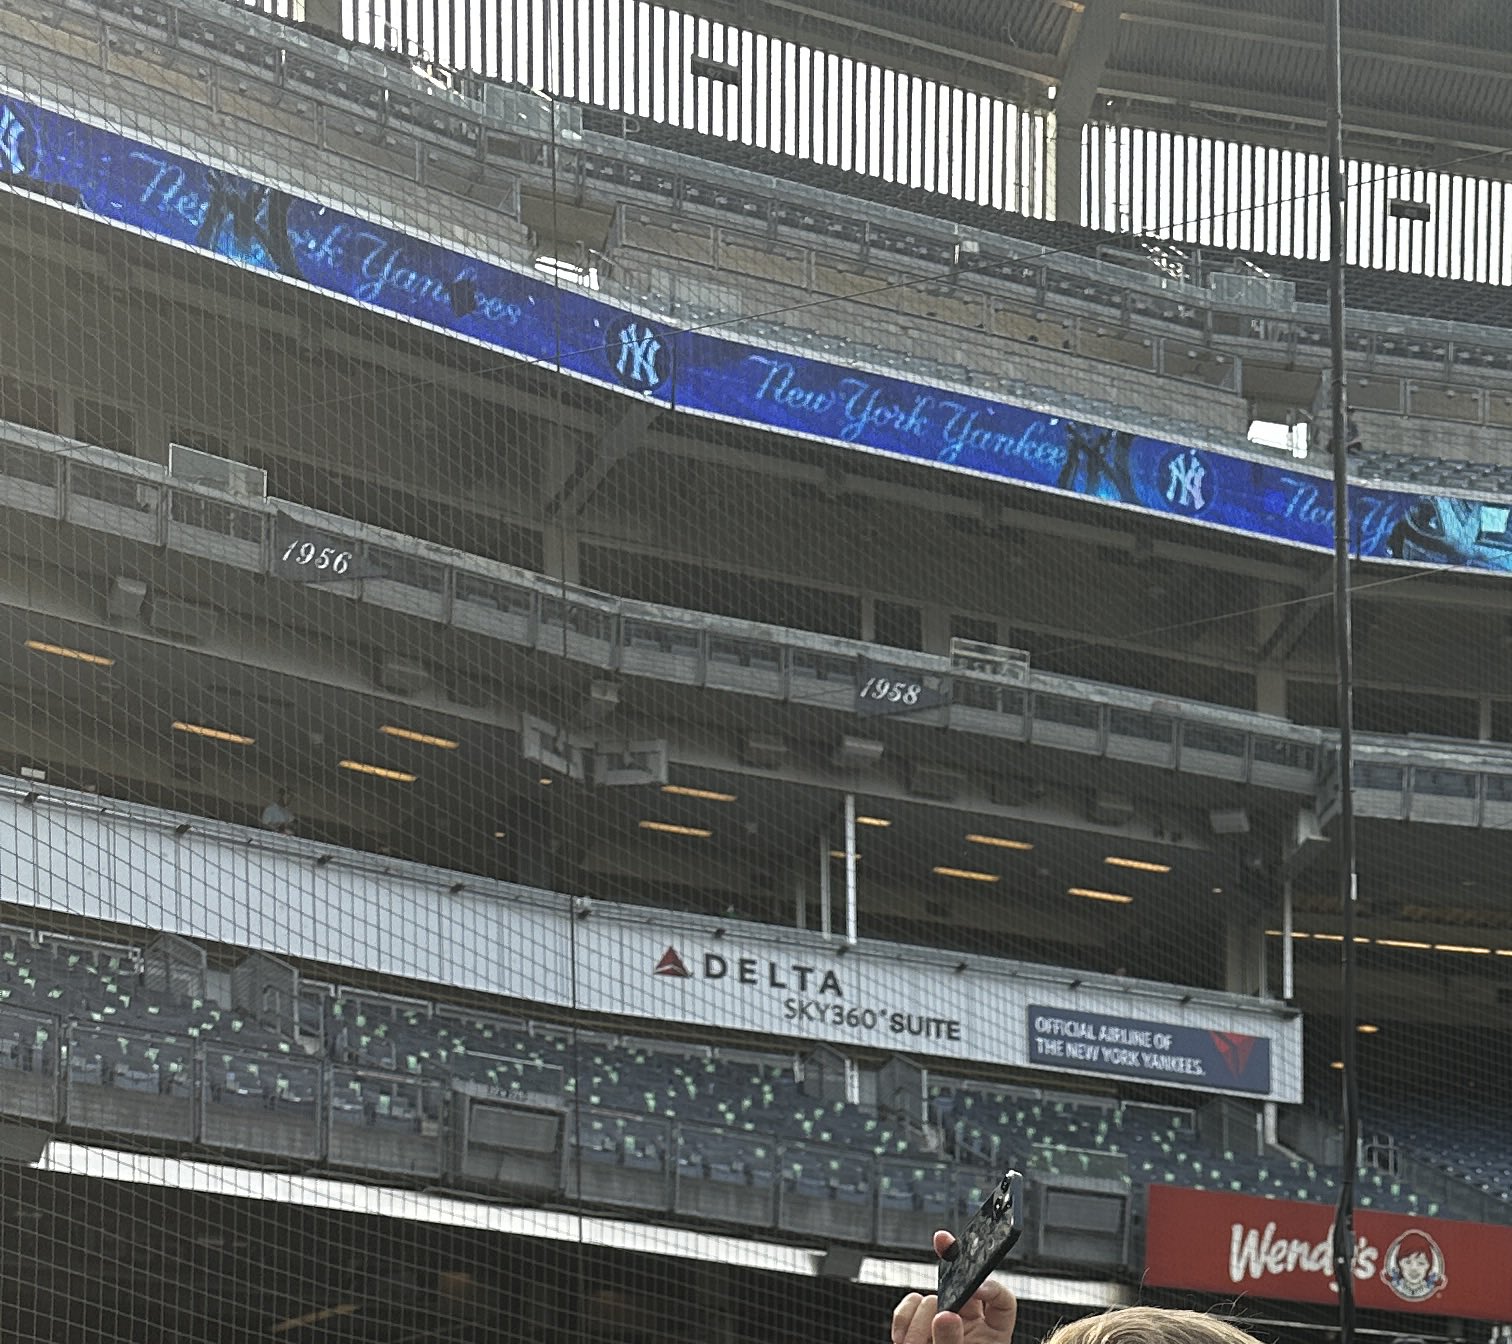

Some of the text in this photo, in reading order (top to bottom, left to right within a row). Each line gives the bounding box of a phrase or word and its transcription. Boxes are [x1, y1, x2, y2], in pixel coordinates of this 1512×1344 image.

[616, 323, 661, 387] NY
[747, 354, 836, 413] New
[841, 378, 936, 441] York
[1166, 451, 1206, 511] NY
[282, 540, 353, 574] 1956
[860, 677, 921, 705] 1958
[705, 953, 844, 997] DELTA
[889, 1011, 961, 1041] SUITE
[1034, 1016, 1173, 1050] OFFICIAL AIRLINE OF
[1034, 1037, 1064, 1057] THE
[1066, 1042, 1100, 1061] NEW
[1101, 1046, 1141, 1067] YORK
